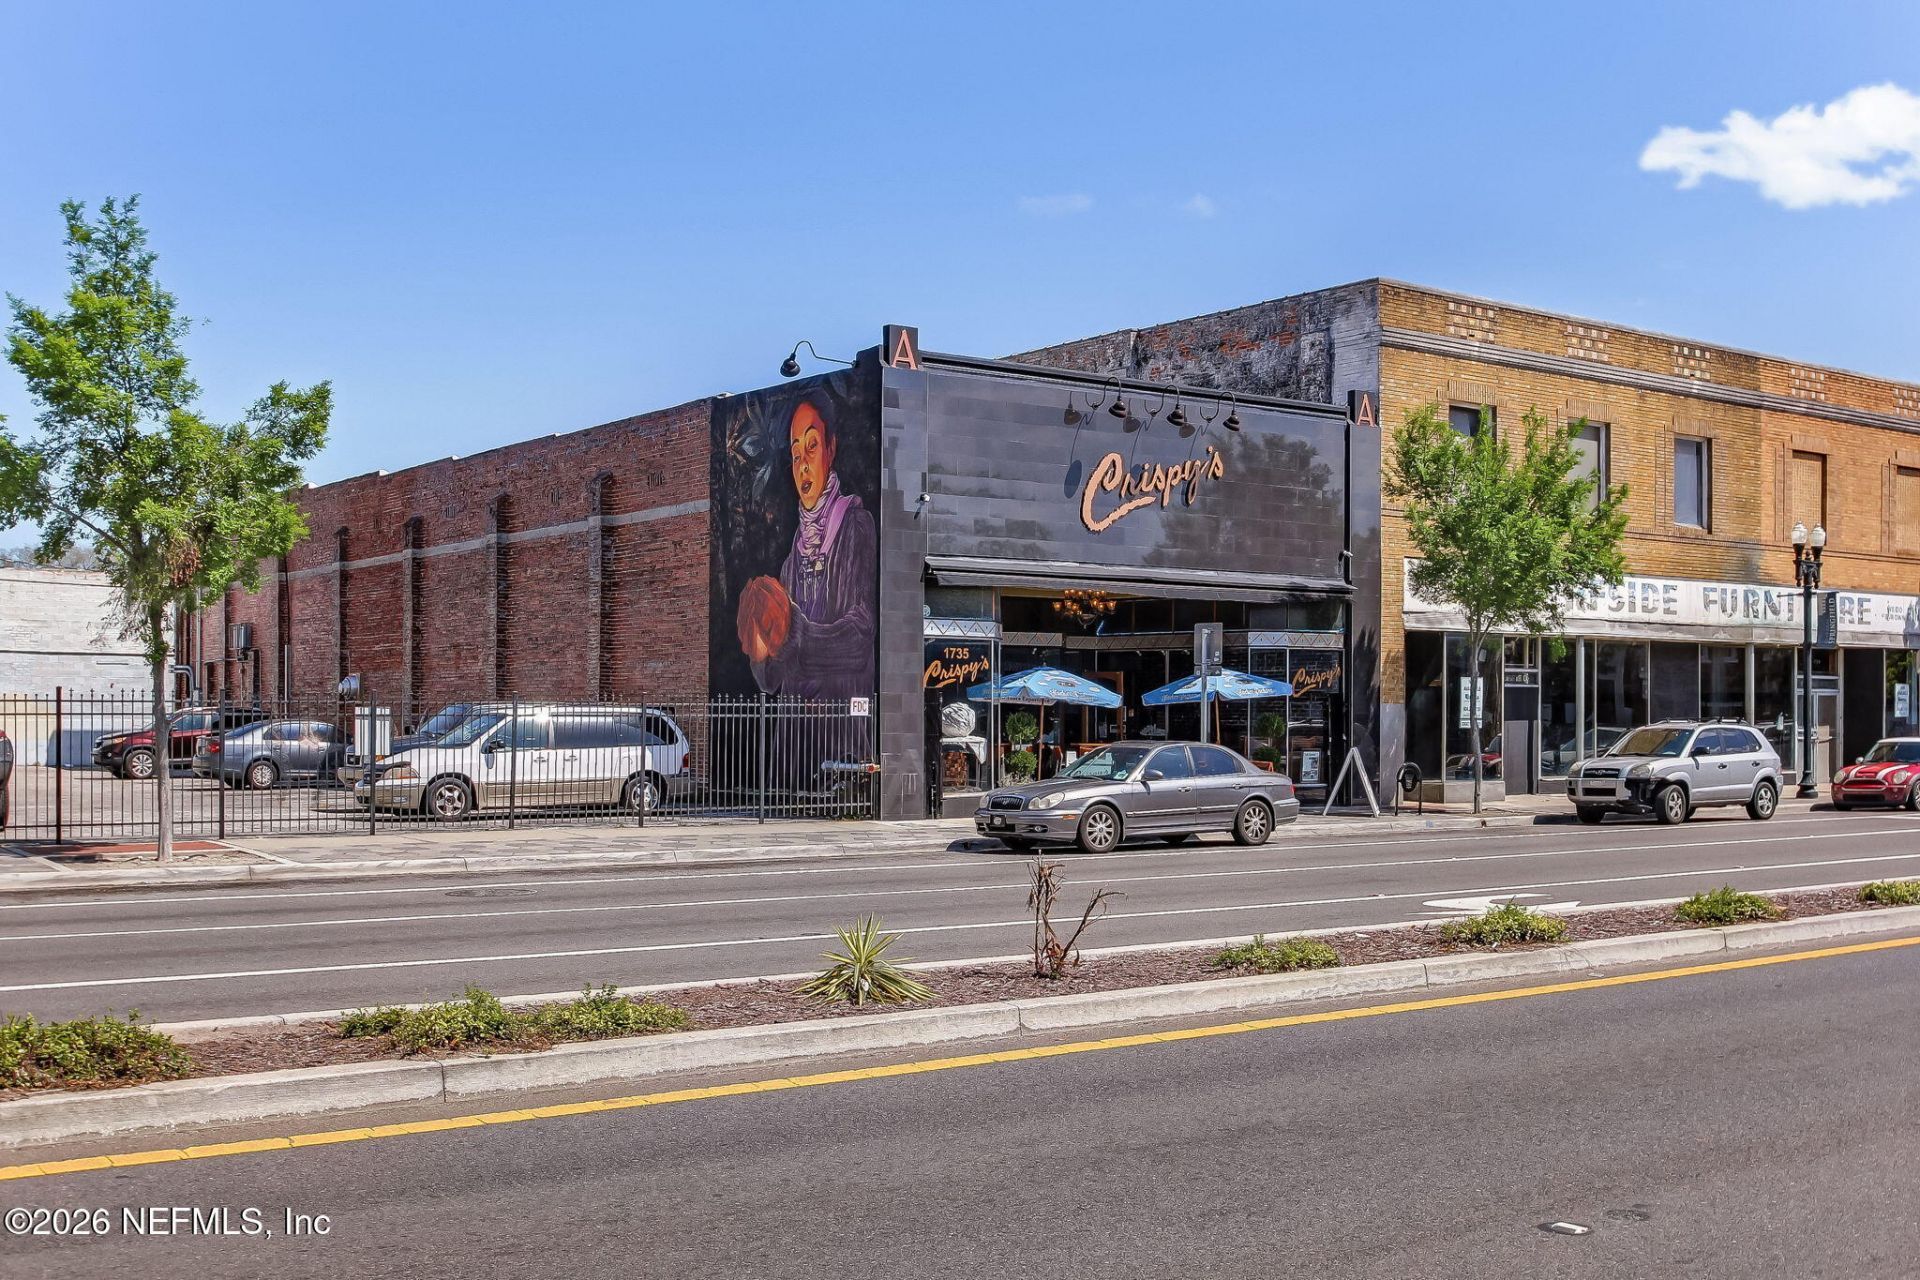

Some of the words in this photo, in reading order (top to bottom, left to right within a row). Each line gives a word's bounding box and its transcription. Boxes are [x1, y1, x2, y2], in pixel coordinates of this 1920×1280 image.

[891, 329, 918, 370] A
[1357, 393, 1375, 427] A
[1081, 445, 1224, 532] Crispy's
[1703, 586, 1871, 625] FURNIRE
[943, 647, 970, 659] 1735
[922, 655, 990, 688] Crispy's
[1292, 664, 1342, 698] Crispy's
[853, 700, 867, 713] FDC
